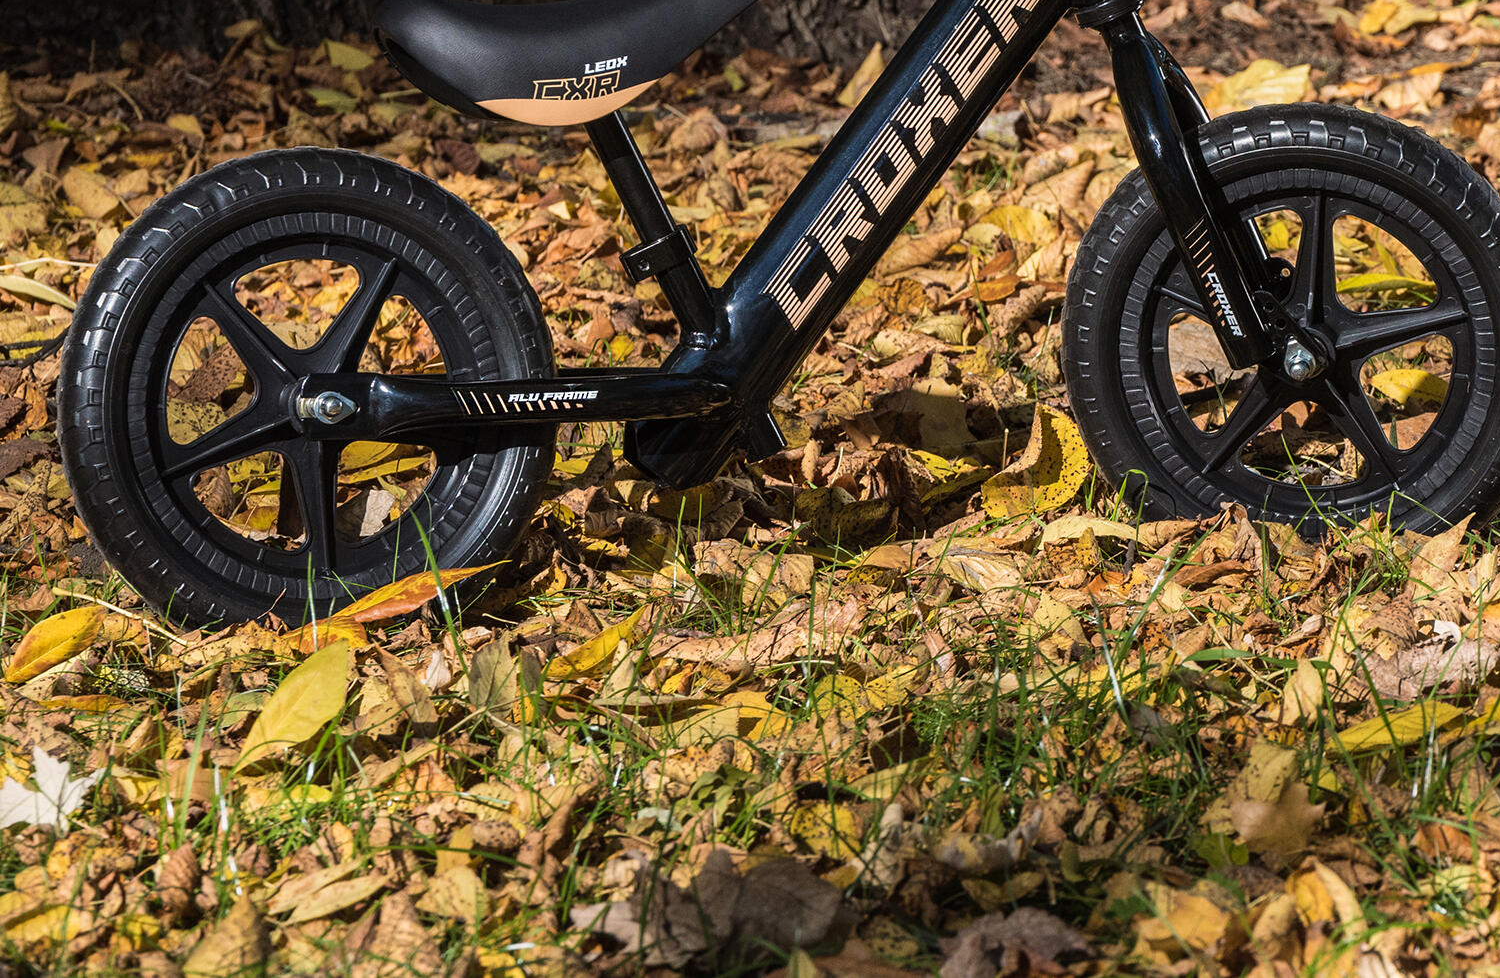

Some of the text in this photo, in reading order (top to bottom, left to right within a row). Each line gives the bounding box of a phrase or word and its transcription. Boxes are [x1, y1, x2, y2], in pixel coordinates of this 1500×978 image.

[583, 55, 628, 74] LEOX
[532, 69, 620, 100] CXR
[1206, 272, 1247, 338] CROXER
[508, 390, 599, 403] ALU FRAME
